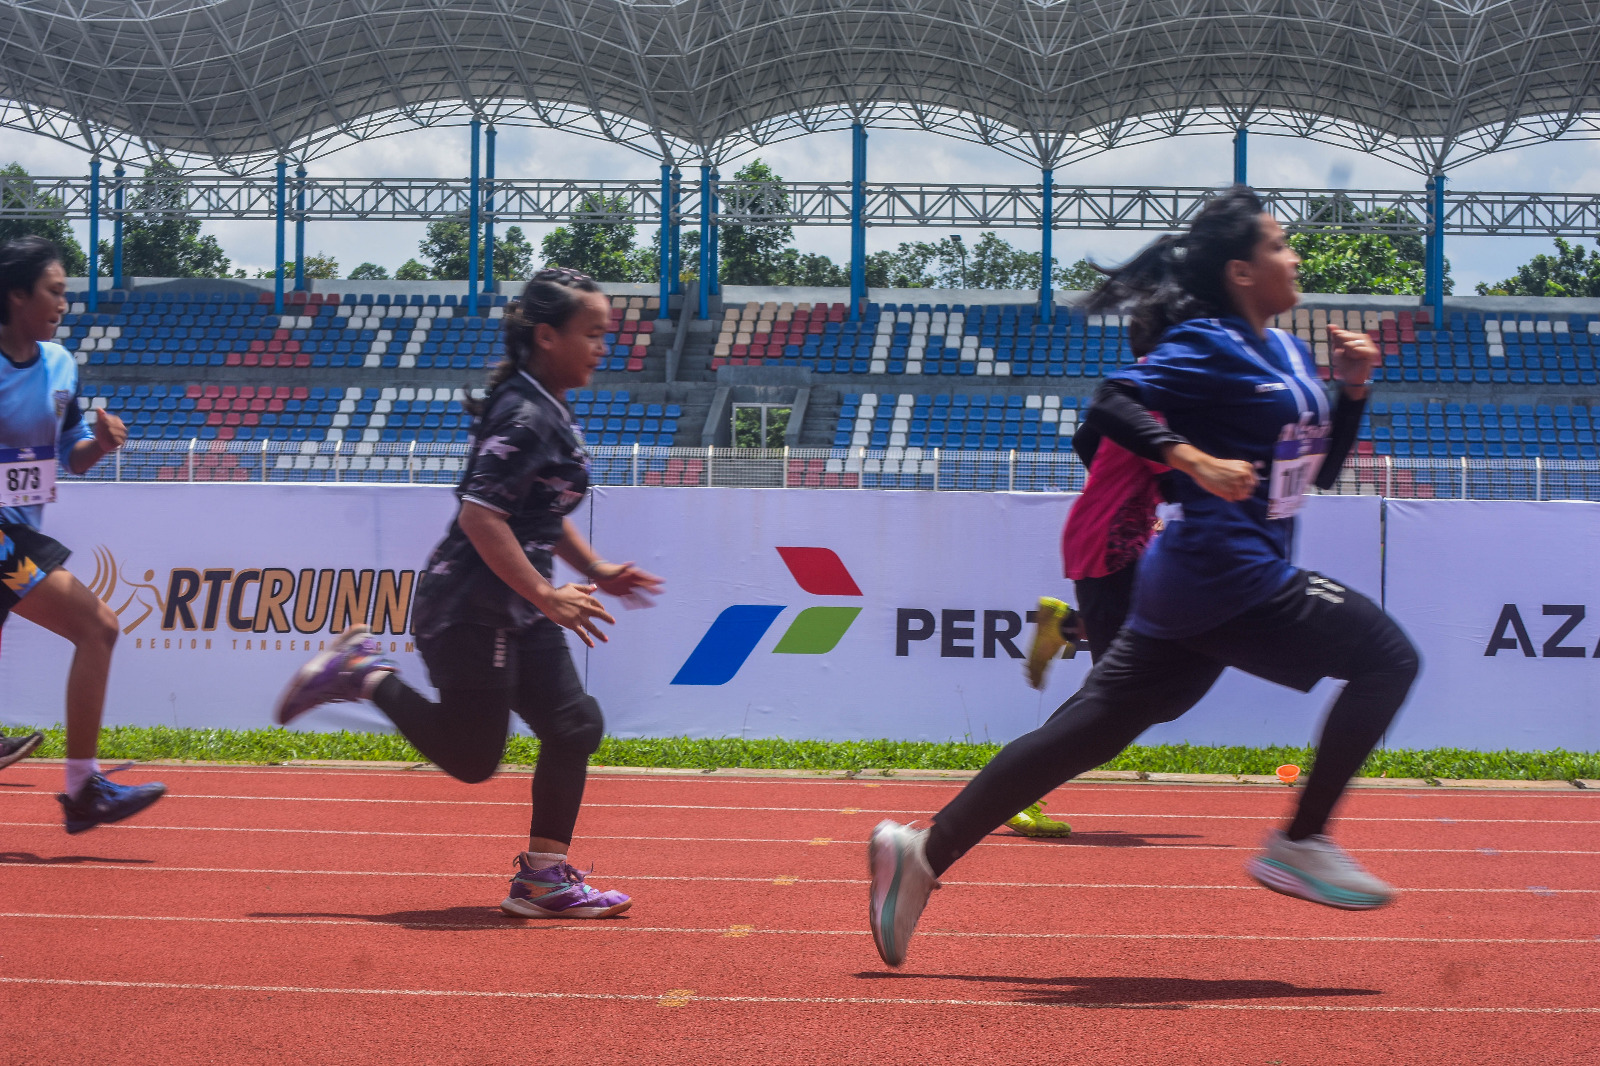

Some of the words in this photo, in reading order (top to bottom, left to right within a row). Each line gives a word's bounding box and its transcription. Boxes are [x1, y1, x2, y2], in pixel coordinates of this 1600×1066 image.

[7, 467, 40, 491] 873
[160, 568, 427, 635] RTCRUNN
[135, 638, 212, 650] REGION
[232, 639, 325, 652] TANGERA
[375, 641, 414, 653] COM
[896, 608, 1090, 660] PER
[1484, 603, 1600, 659] AZ
